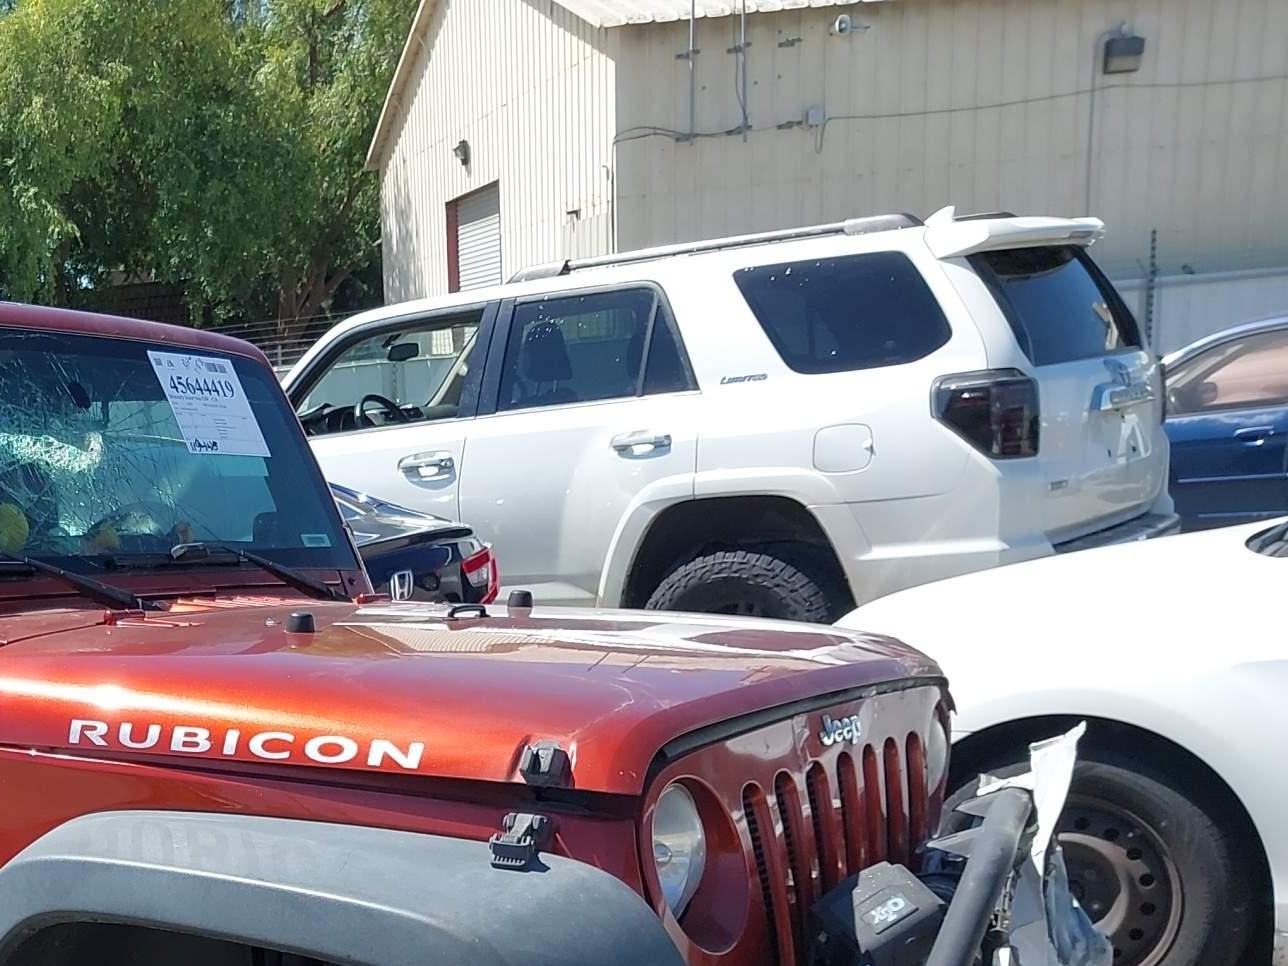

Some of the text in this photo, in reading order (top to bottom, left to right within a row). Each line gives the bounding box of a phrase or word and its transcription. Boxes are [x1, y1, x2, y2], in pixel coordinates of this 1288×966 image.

[169, 374, 234, 397] 45644419
[67, 719, 426, 769] RUBICON
[819, 714, 862, 746] Jeep
